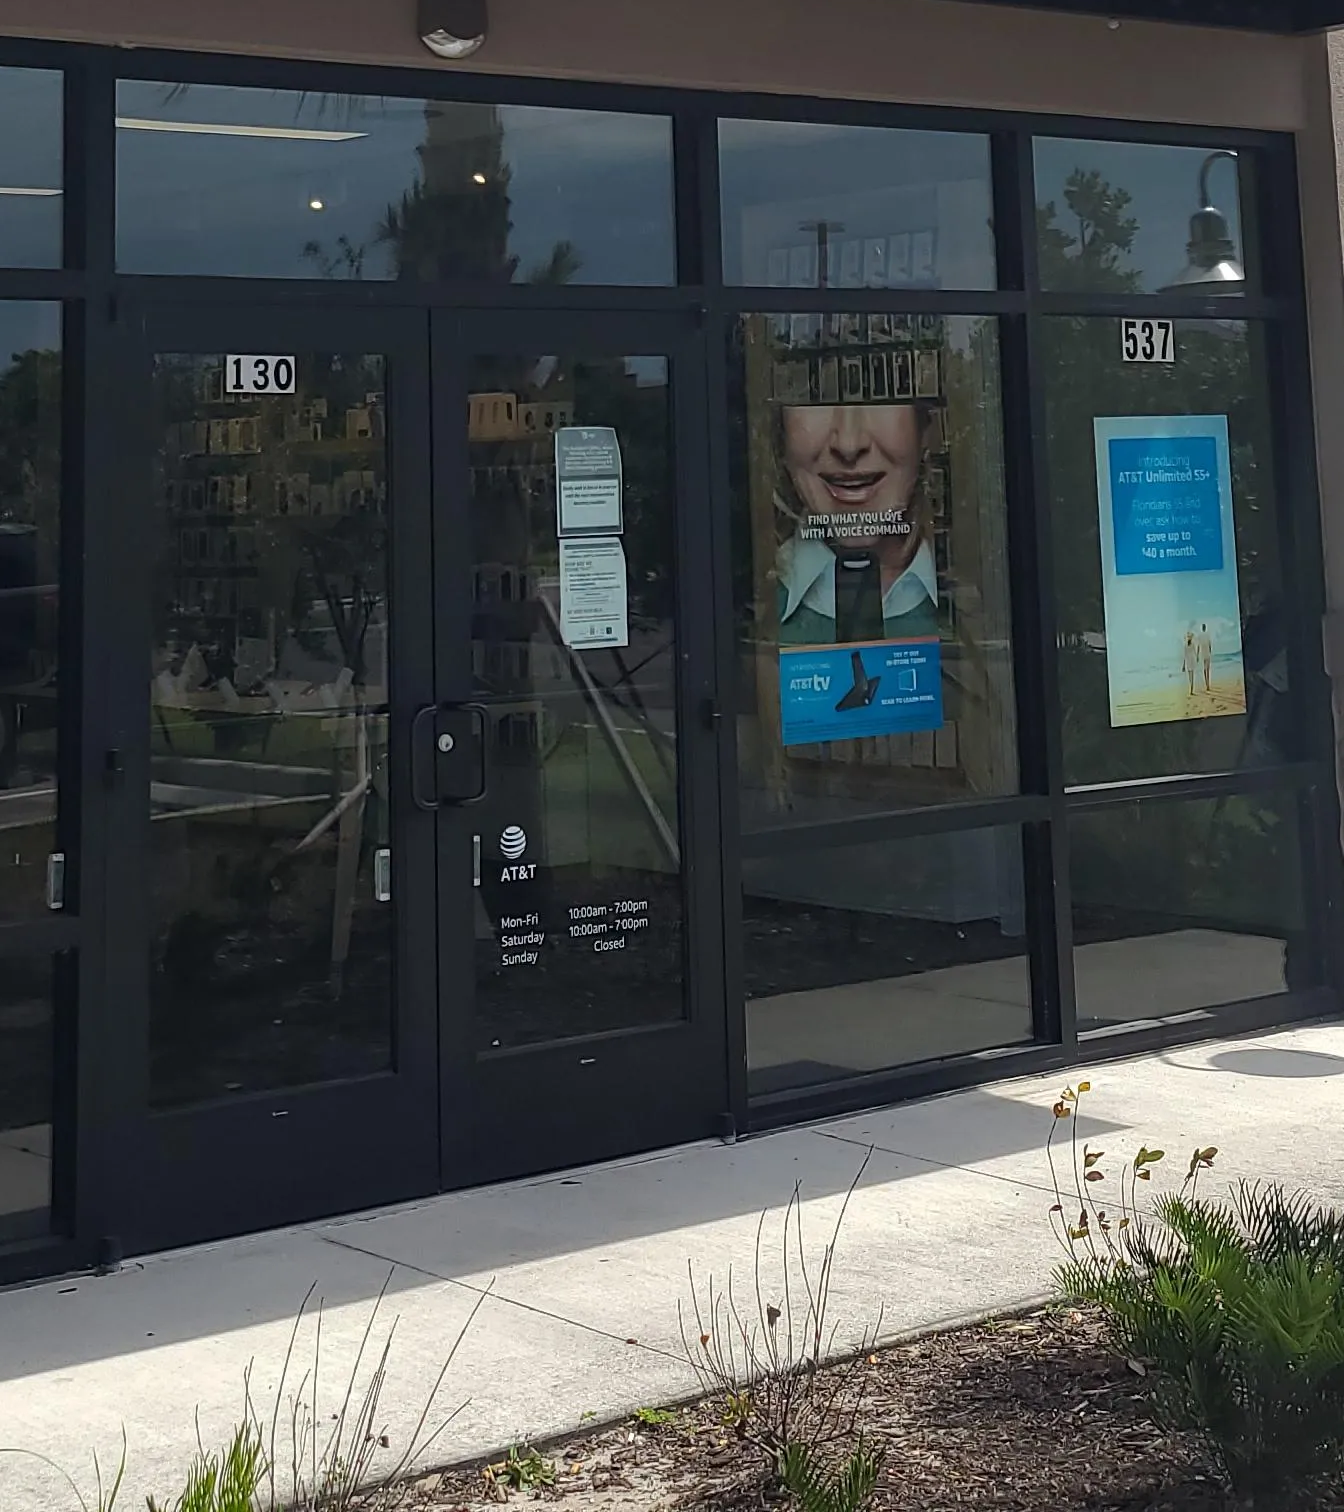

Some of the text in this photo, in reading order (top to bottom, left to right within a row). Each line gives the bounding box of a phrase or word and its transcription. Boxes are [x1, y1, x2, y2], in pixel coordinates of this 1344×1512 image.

[1125, 321, 1171, 360] 537
[233, 357, 293, 390] 130
[1119, 471, 1143, 484] AT&T
[1146, 470, 1192, 483] Unlimited
[808, 511, 903, 525] FIND WHAT YOU LOVE
[801, 524, 911, 539] WITH A VOICE COMMAND
[1145, 531, 1191, 544] save up to
[1159, 549, 1165, 558] a
[501, 864, 537, 882] AT&T
[501, 913, 539, 929] Mon-Fri
[568, 906, 607, 920] 10:00am
[614, 900, 648, 914] 7:00pm
[501, 931, 545, 948] Saturday
[569, 923, 607, 937] 10:00am
[501, 936, 625, 966] Sunday Closed
